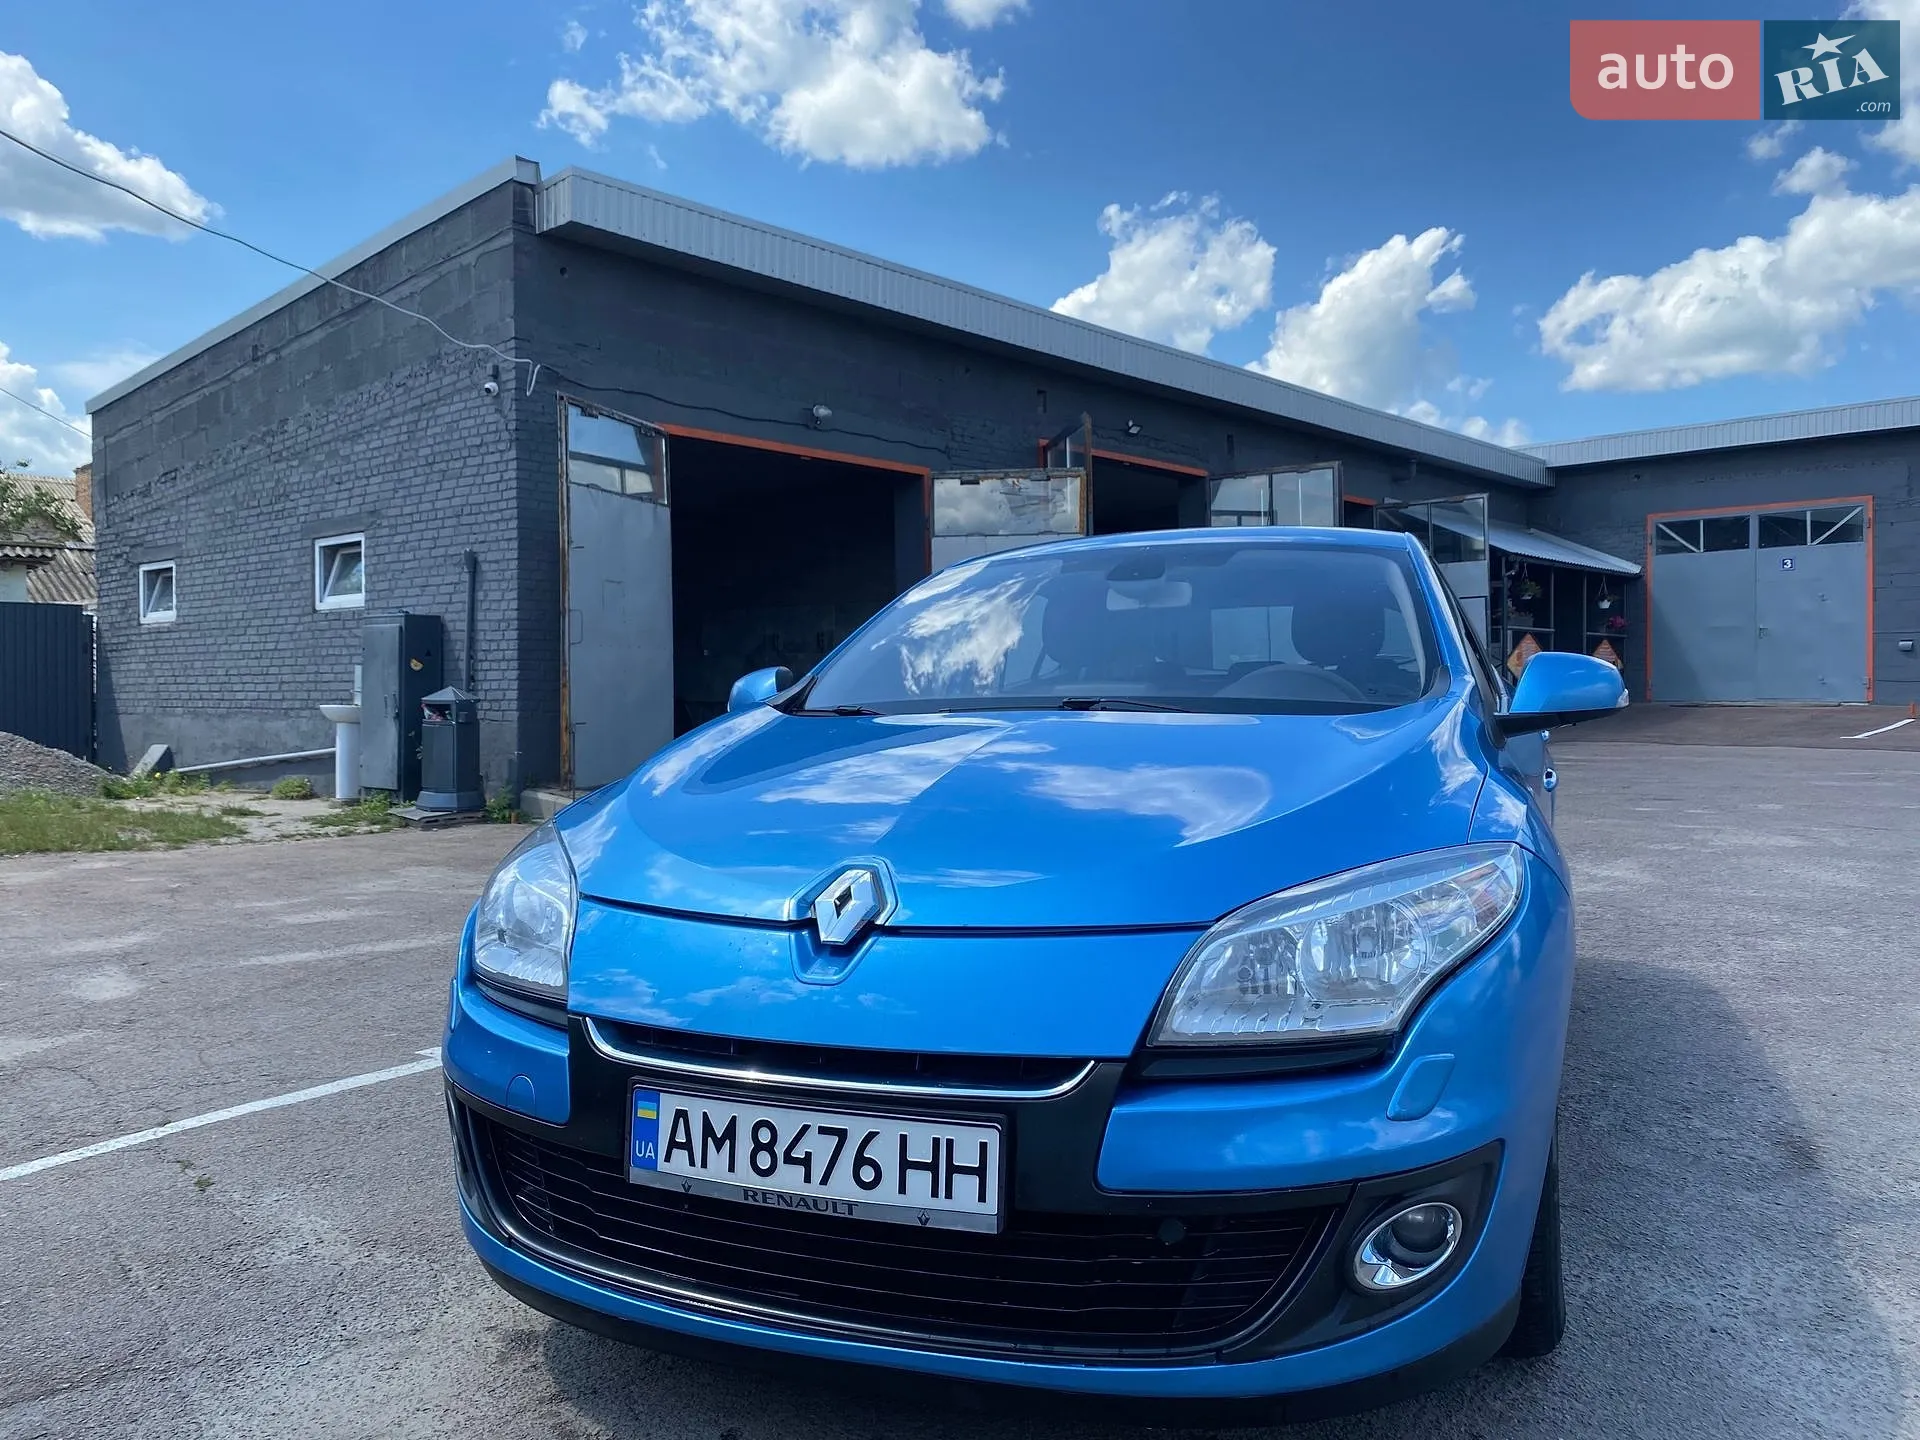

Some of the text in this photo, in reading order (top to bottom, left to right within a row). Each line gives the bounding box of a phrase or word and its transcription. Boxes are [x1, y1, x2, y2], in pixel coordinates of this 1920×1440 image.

[1783, 559, 1792, 569] 3
[635, 1140, 656, 1160] UA
[742, 1189, 859, 1217] RENAULT
